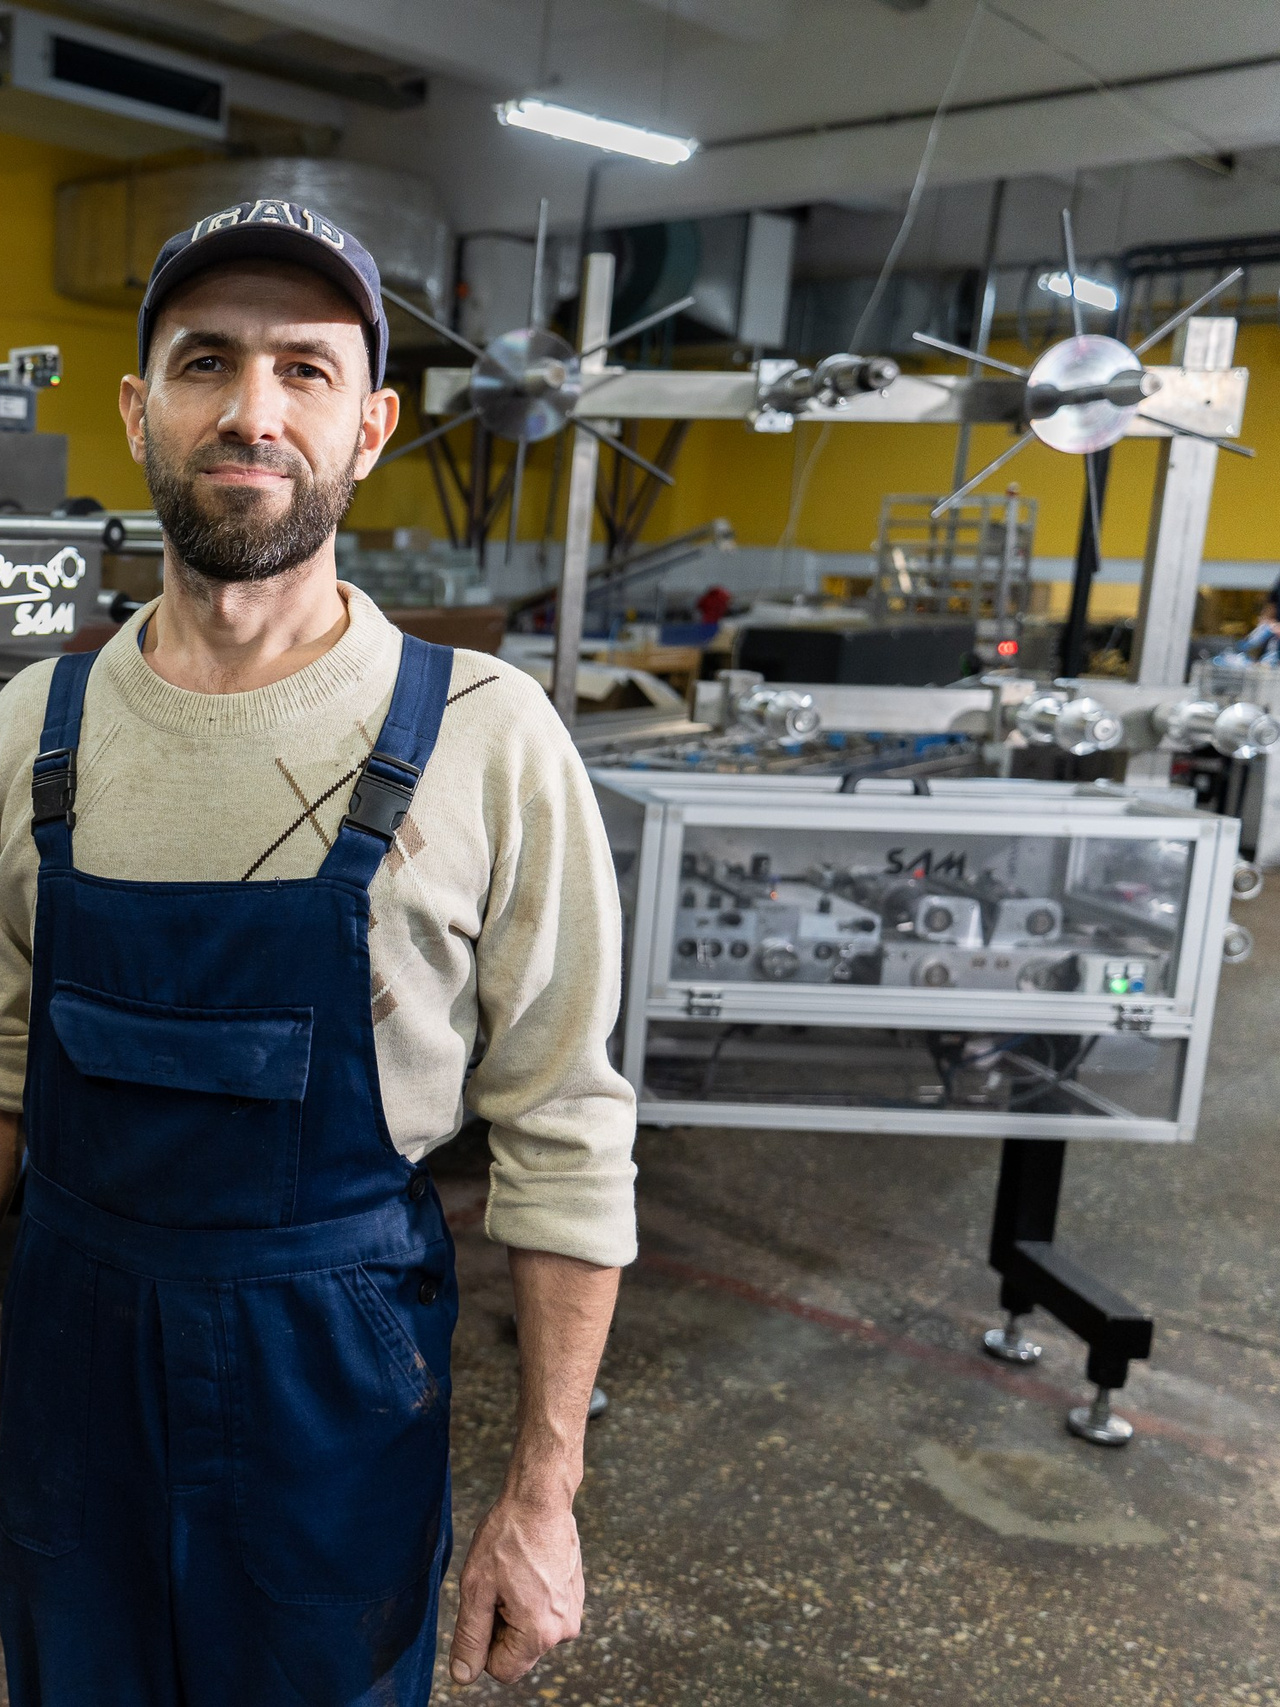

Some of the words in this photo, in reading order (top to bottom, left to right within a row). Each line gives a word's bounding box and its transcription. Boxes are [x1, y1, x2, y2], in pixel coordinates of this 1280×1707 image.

[191, 199, 345, 250] GAP
[11, 602, 75, 636] SAM
[884, 848, 967, 879] SAM
